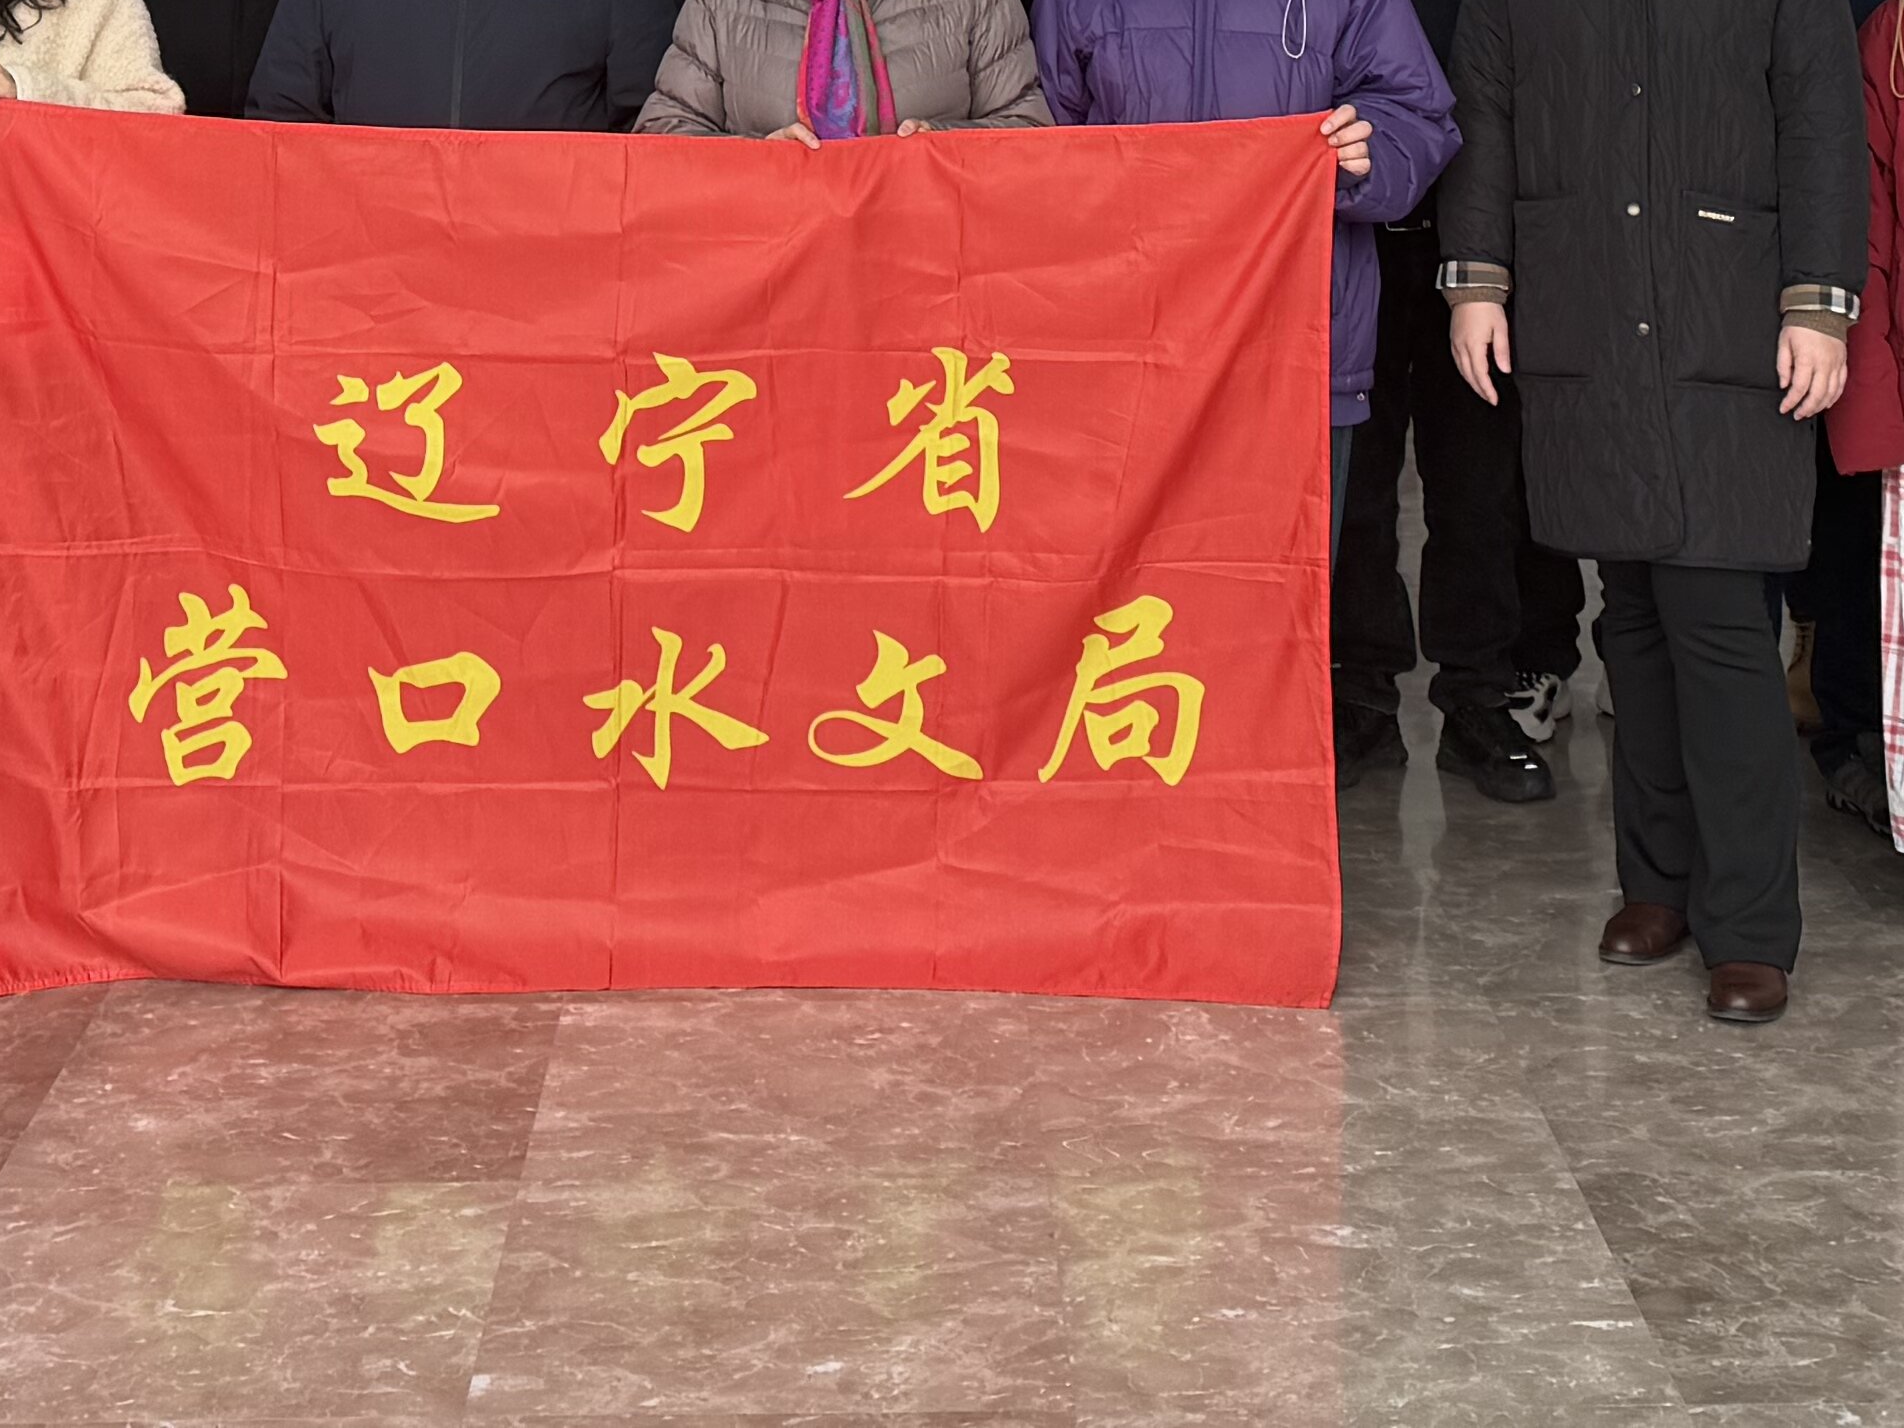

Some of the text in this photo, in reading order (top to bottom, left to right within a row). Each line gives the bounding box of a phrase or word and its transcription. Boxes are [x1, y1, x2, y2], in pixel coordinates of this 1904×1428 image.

[312, 346, 1017, 533] 辽宁省
[130, 584, 1206, 790] 营口水文局
